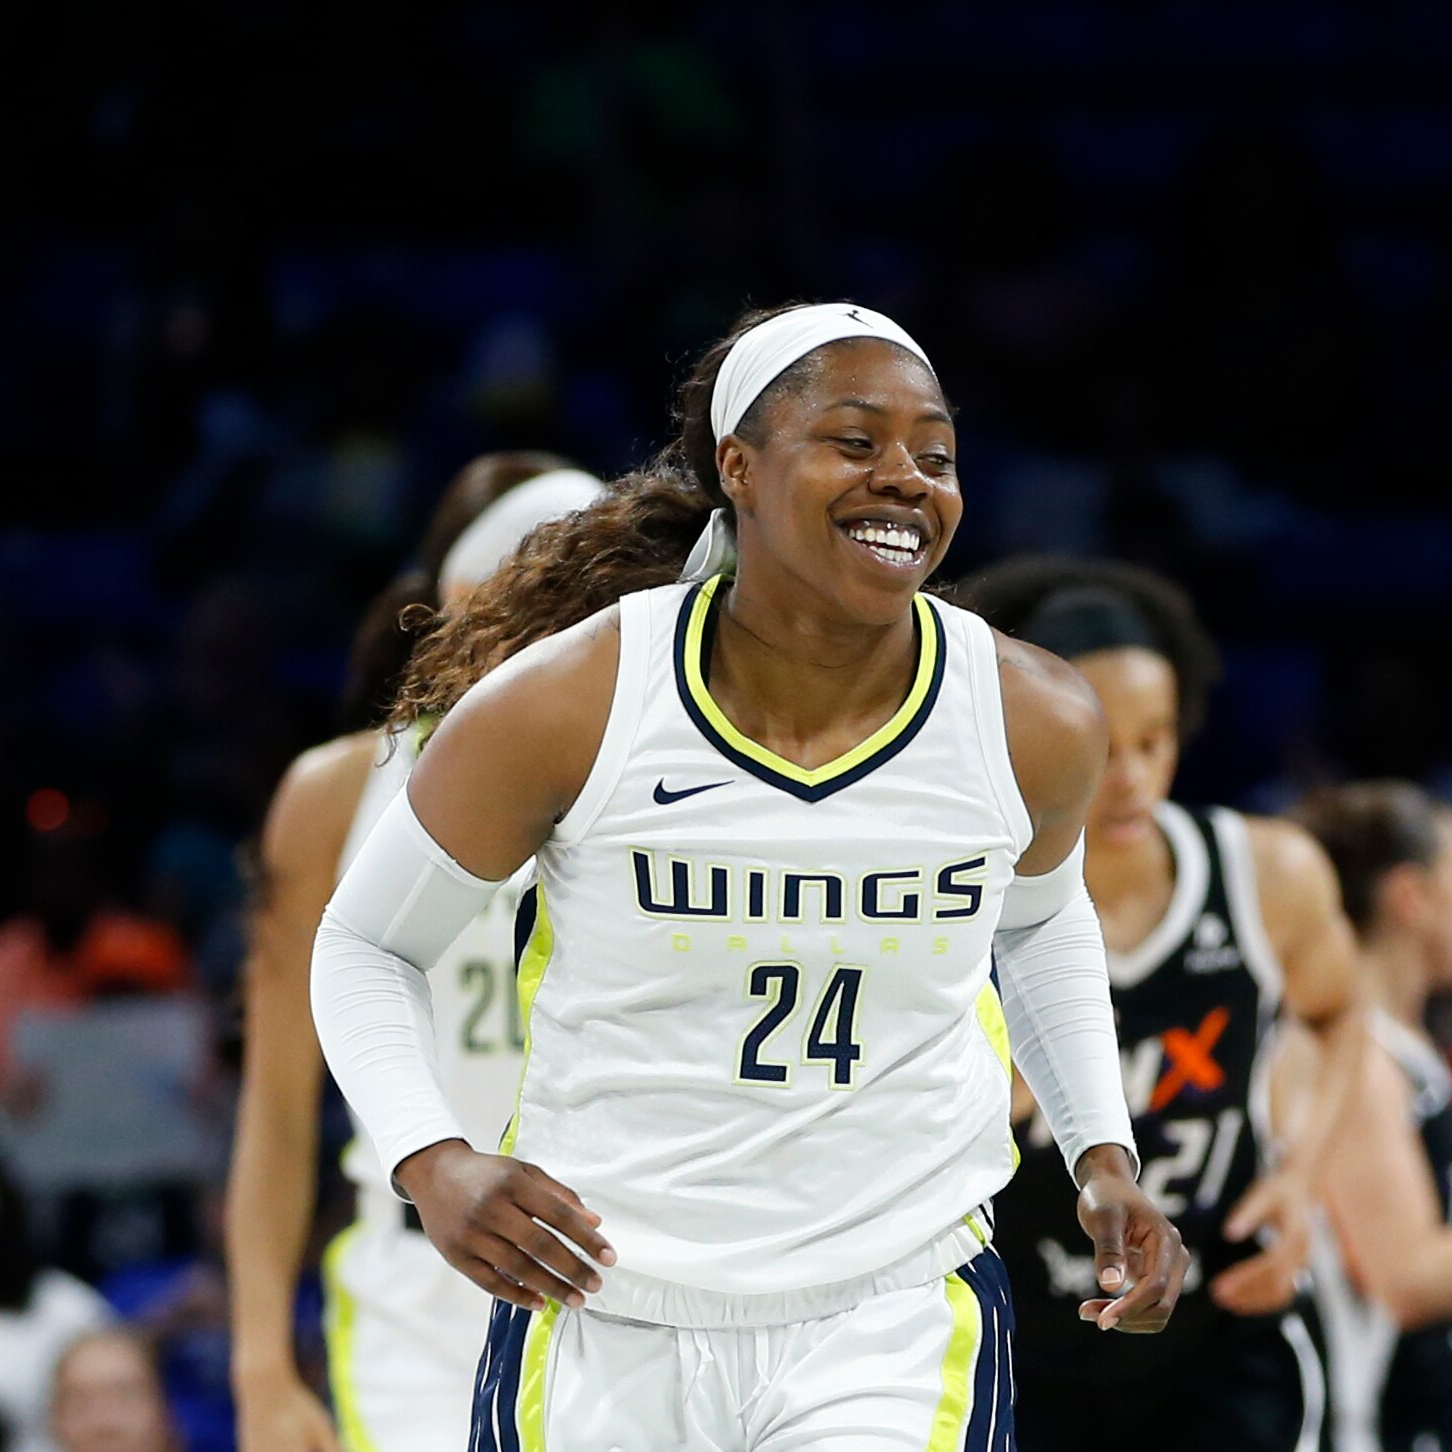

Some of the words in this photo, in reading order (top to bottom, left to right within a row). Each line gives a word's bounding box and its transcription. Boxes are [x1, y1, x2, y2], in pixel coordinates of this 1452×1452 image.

[629, 845, 988, 923] WINGS
[671, 932, 949, 955] DALLAS
[734, 961, 866, 1089] 24
[1139, 1106, 1245, 1218] 21
